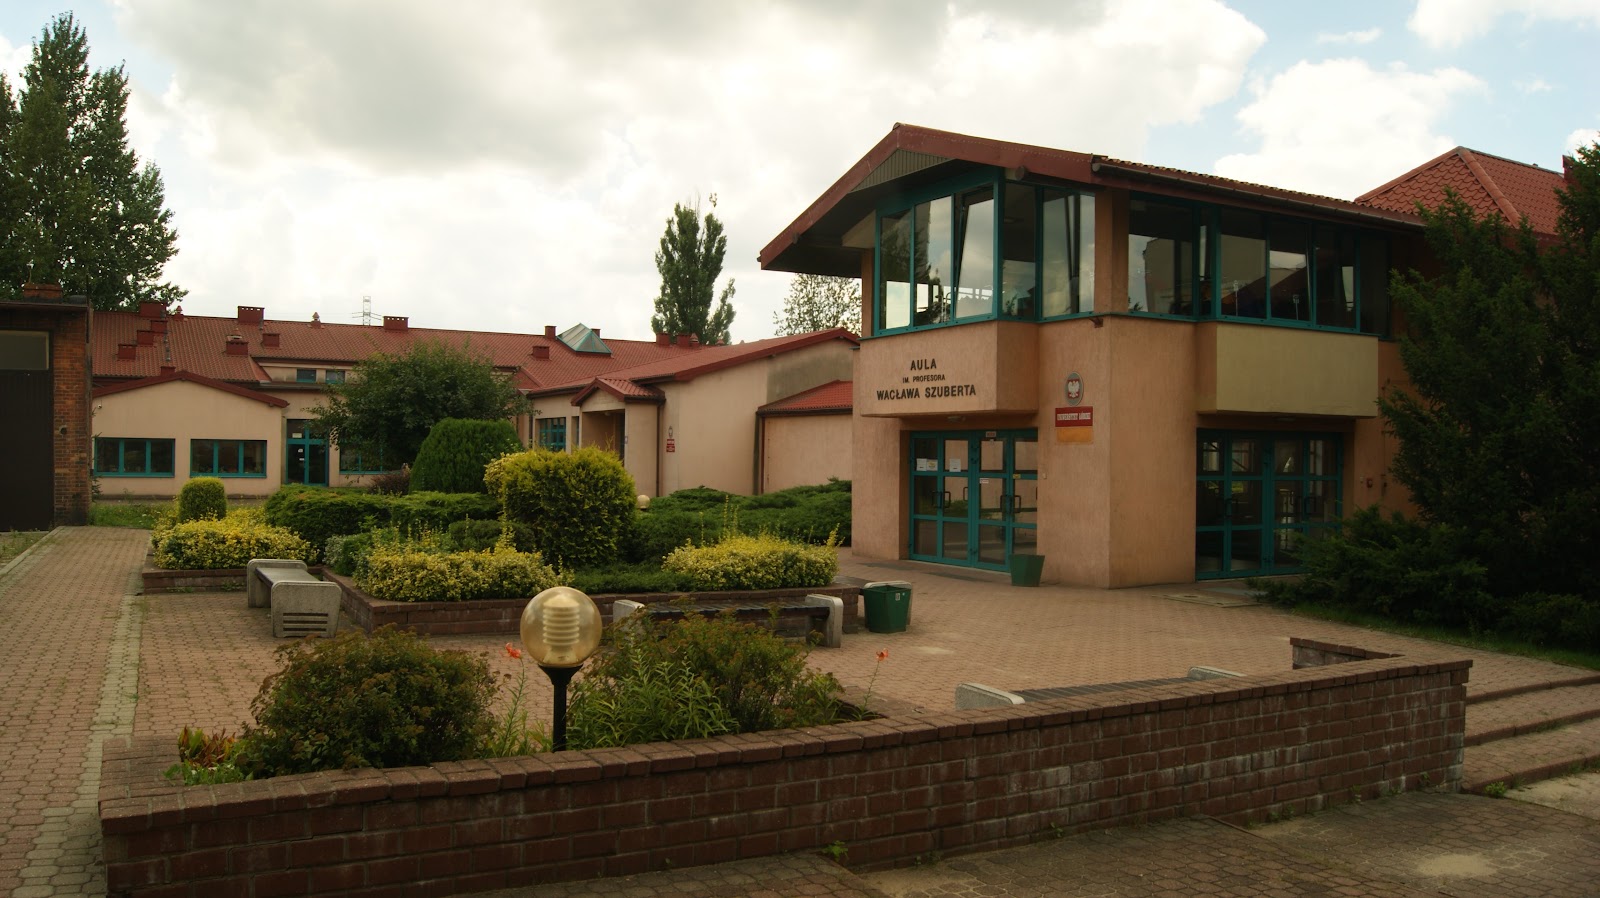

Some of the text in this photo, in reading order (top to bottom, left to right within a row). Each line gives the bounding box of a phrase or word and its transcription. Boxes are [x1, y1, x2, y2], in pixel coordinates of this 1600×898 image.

[910, 358, 937, 371] AULA
[912, 374, 946, 383] PROFESORA
[876, 384, 976, 401] WACŁAWA SZUBERTA
